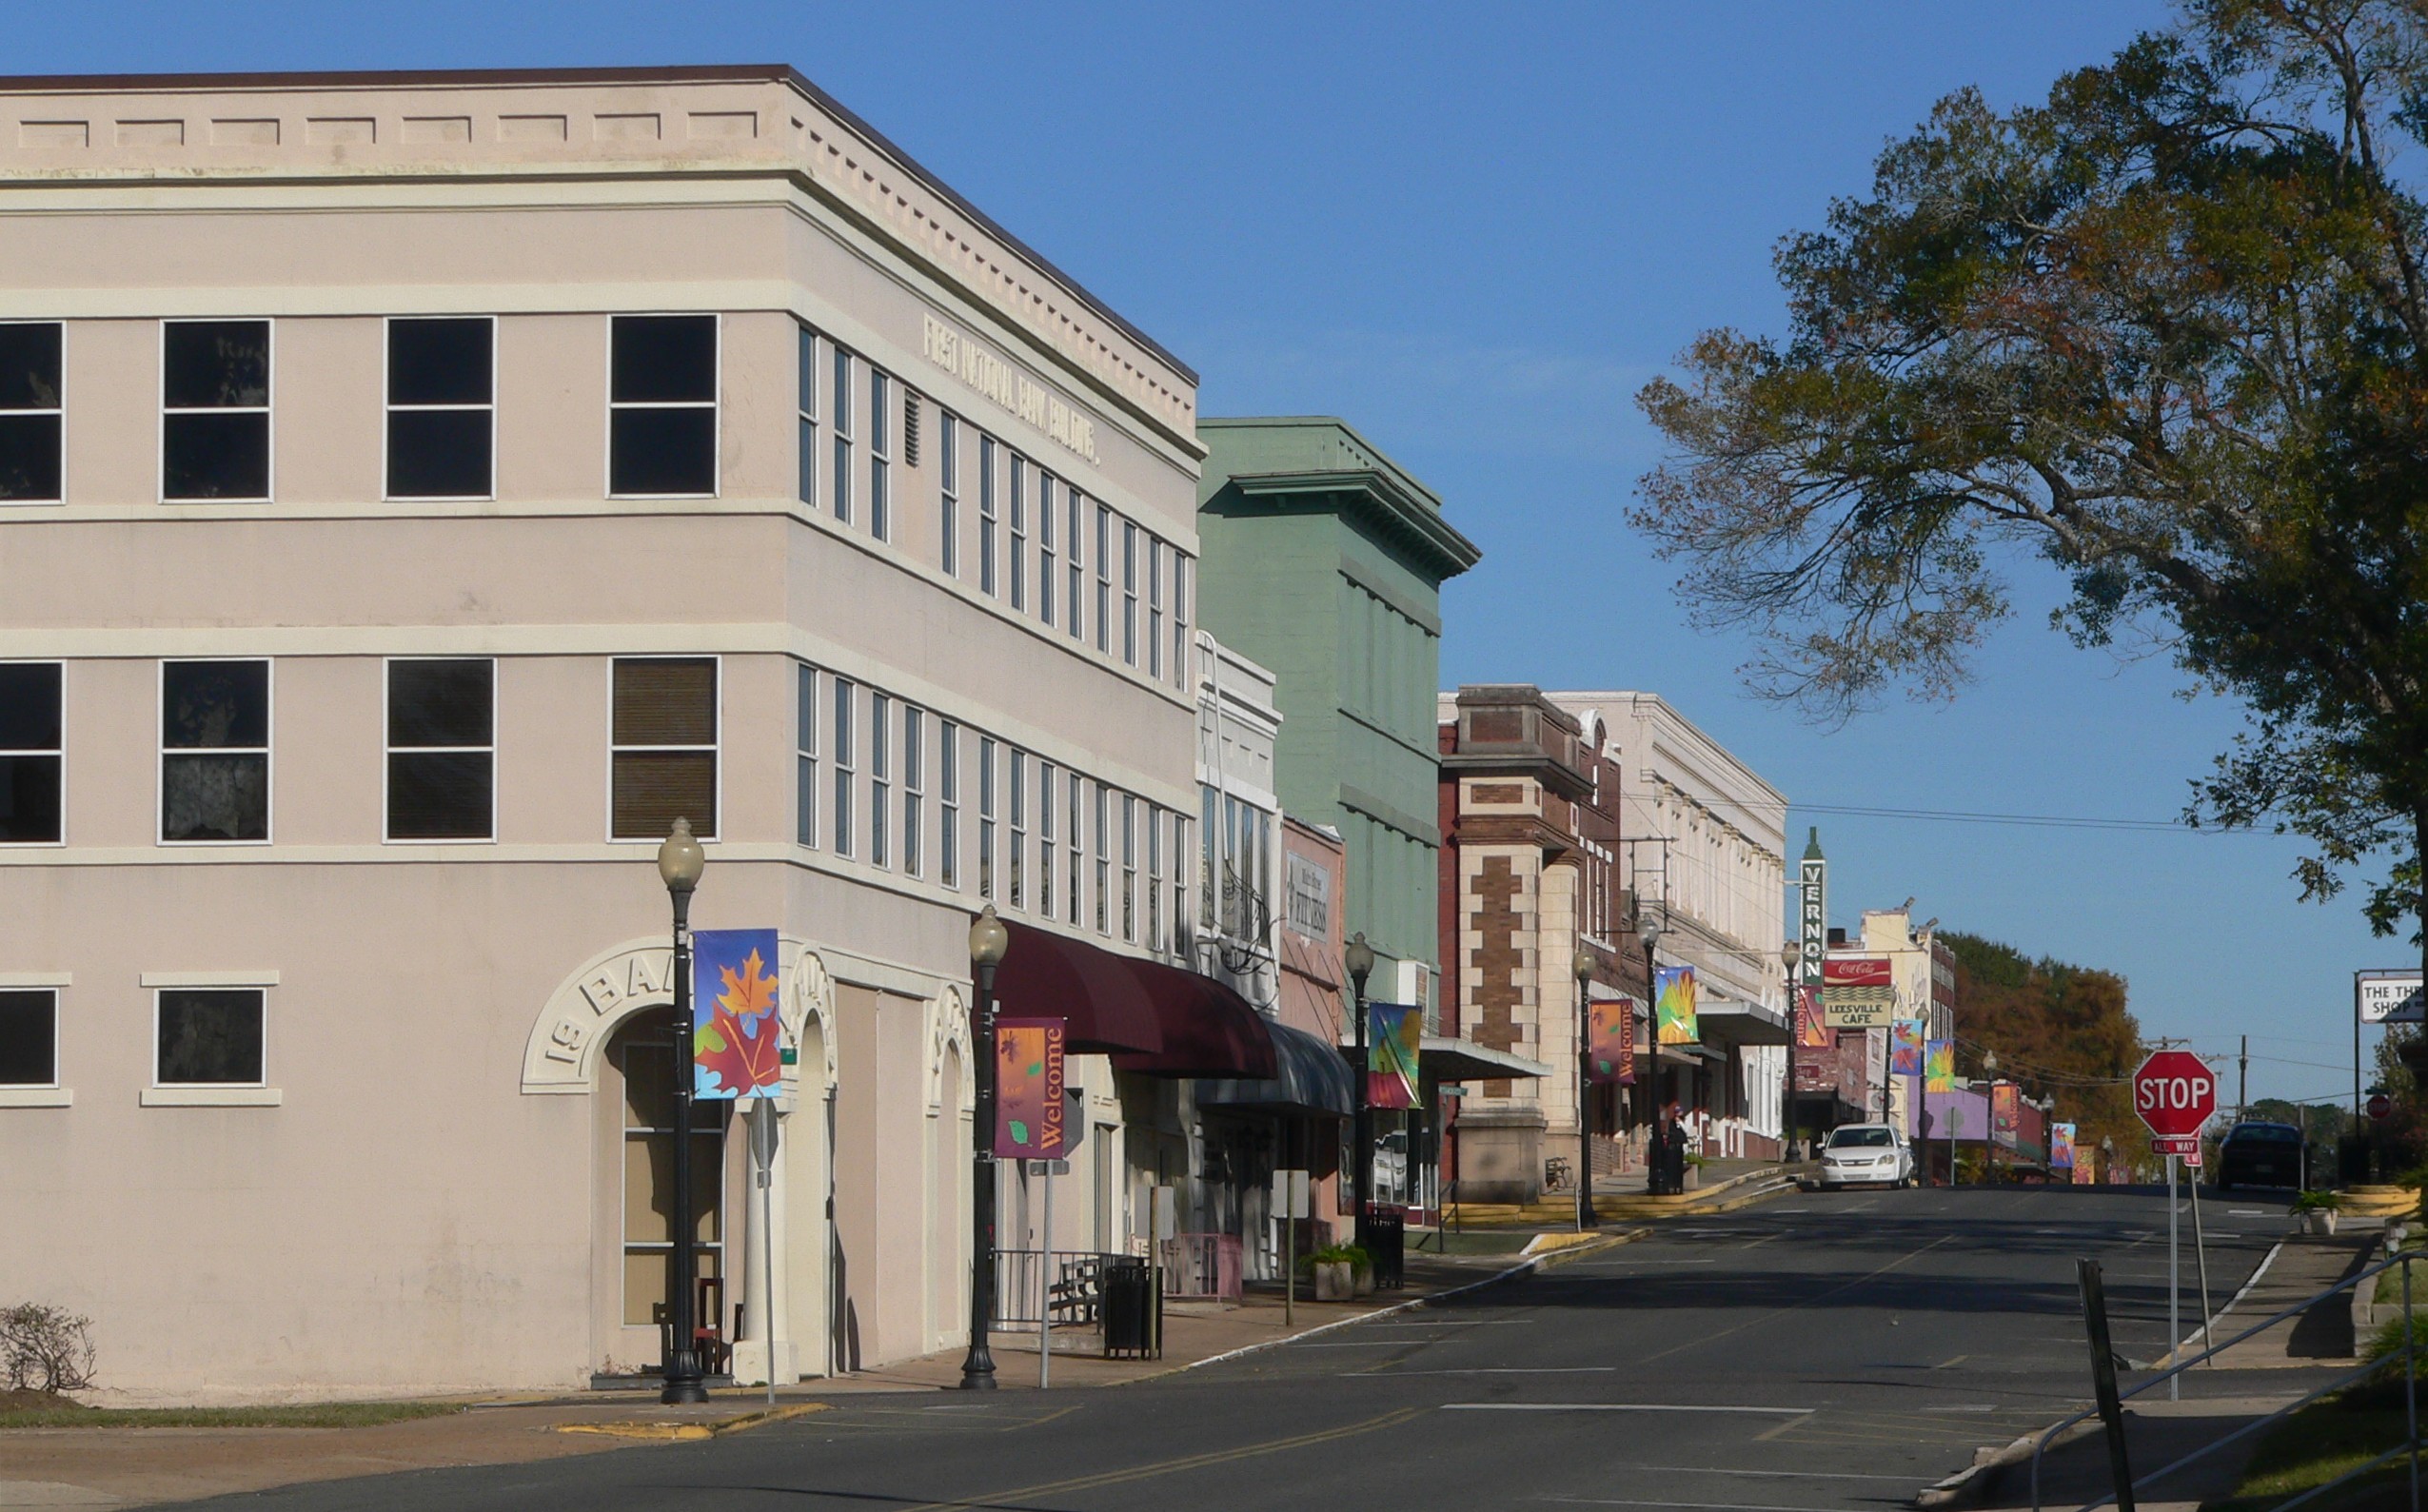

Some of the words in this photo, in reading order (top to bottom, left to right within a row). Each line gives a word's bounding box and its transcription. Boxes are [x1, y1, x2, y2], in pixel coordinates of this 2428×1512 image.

[924, 312, 958, 375] FIRST
[961, 338, 1017, 415] NATIONAL
[1018, 375, 1047, 431] BANK
[1295, 891, 1327, 933] FITNESS
[1804, 866, 1822, 977] VERNON
[2363, 986, 2390, 999] THE
[2373, 1001, 2411, 1014] SHOP
[1828, 1004, 1884, 1014] LEESVILLE
[1842, 1013, 1872, 1025] CAFE
[1618, 1004, 1633, 1078] Welcome
[1040, 1028, 1062, 1150] Welcome
[2140, 1077, 2210, 1109] STOP
[2154, 1142, 2170, 1152] ALL
[2176, 1142, 2195, 1152] WAY
